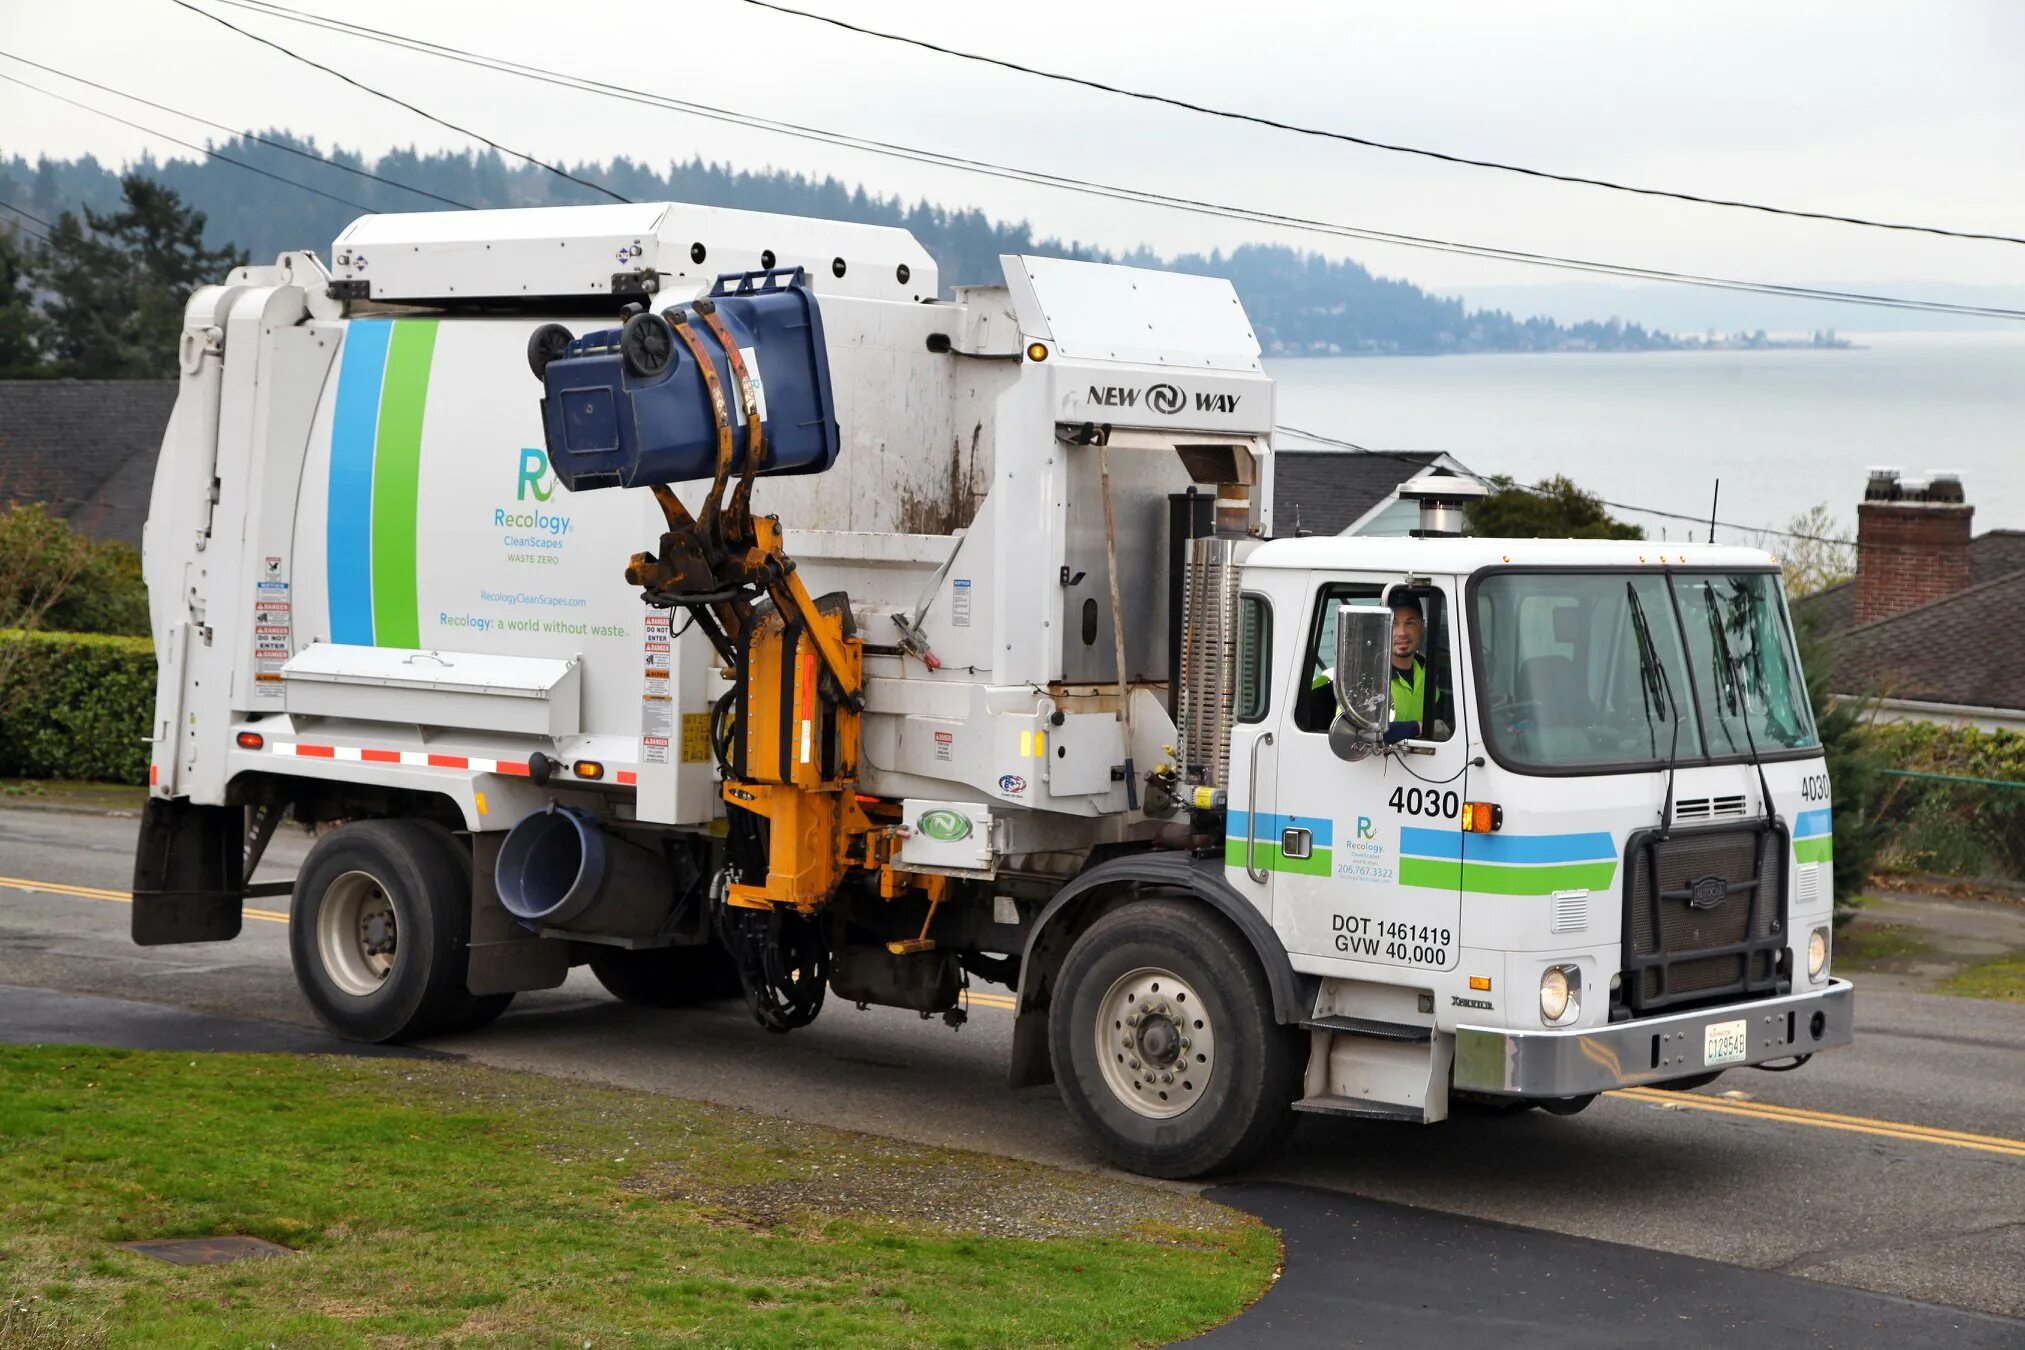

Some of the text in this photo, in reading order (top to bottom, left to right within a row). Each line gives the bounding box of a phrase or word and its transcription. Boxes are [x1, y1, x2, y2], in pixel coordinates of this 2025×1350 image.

[1087, 385, 1142, 407] NEW
[1195, 392, 1241, 414] WAY
[504, 535, 563, 550] CleanScapes
[507, 553, 559, 565] WASTE ZERO
[480, 591, 587, 607] RecologyCleanScapes.com
[440, 612, 494, 631] Recology:
[497, 620, 505, 630] a
[507, 618, 540, 632] world
[543, 621, 588, 636] without
[650, 617, 670, 625] DANGER
[649, 738, 669, 747] DANGER
[1802, 773, 1830, 802] 4030
[1388, 785, 1459, 819] 4030
[1346, 840, 1384, 853] Recology
[1338, 864, 1393, 878] 206.767.3322
[1332, 914, 1451, 946] DOT 1461419
[1335, 934, 1446, 965] GVW 40,000
[1708, 1034, 1745, 1059] C12954B
